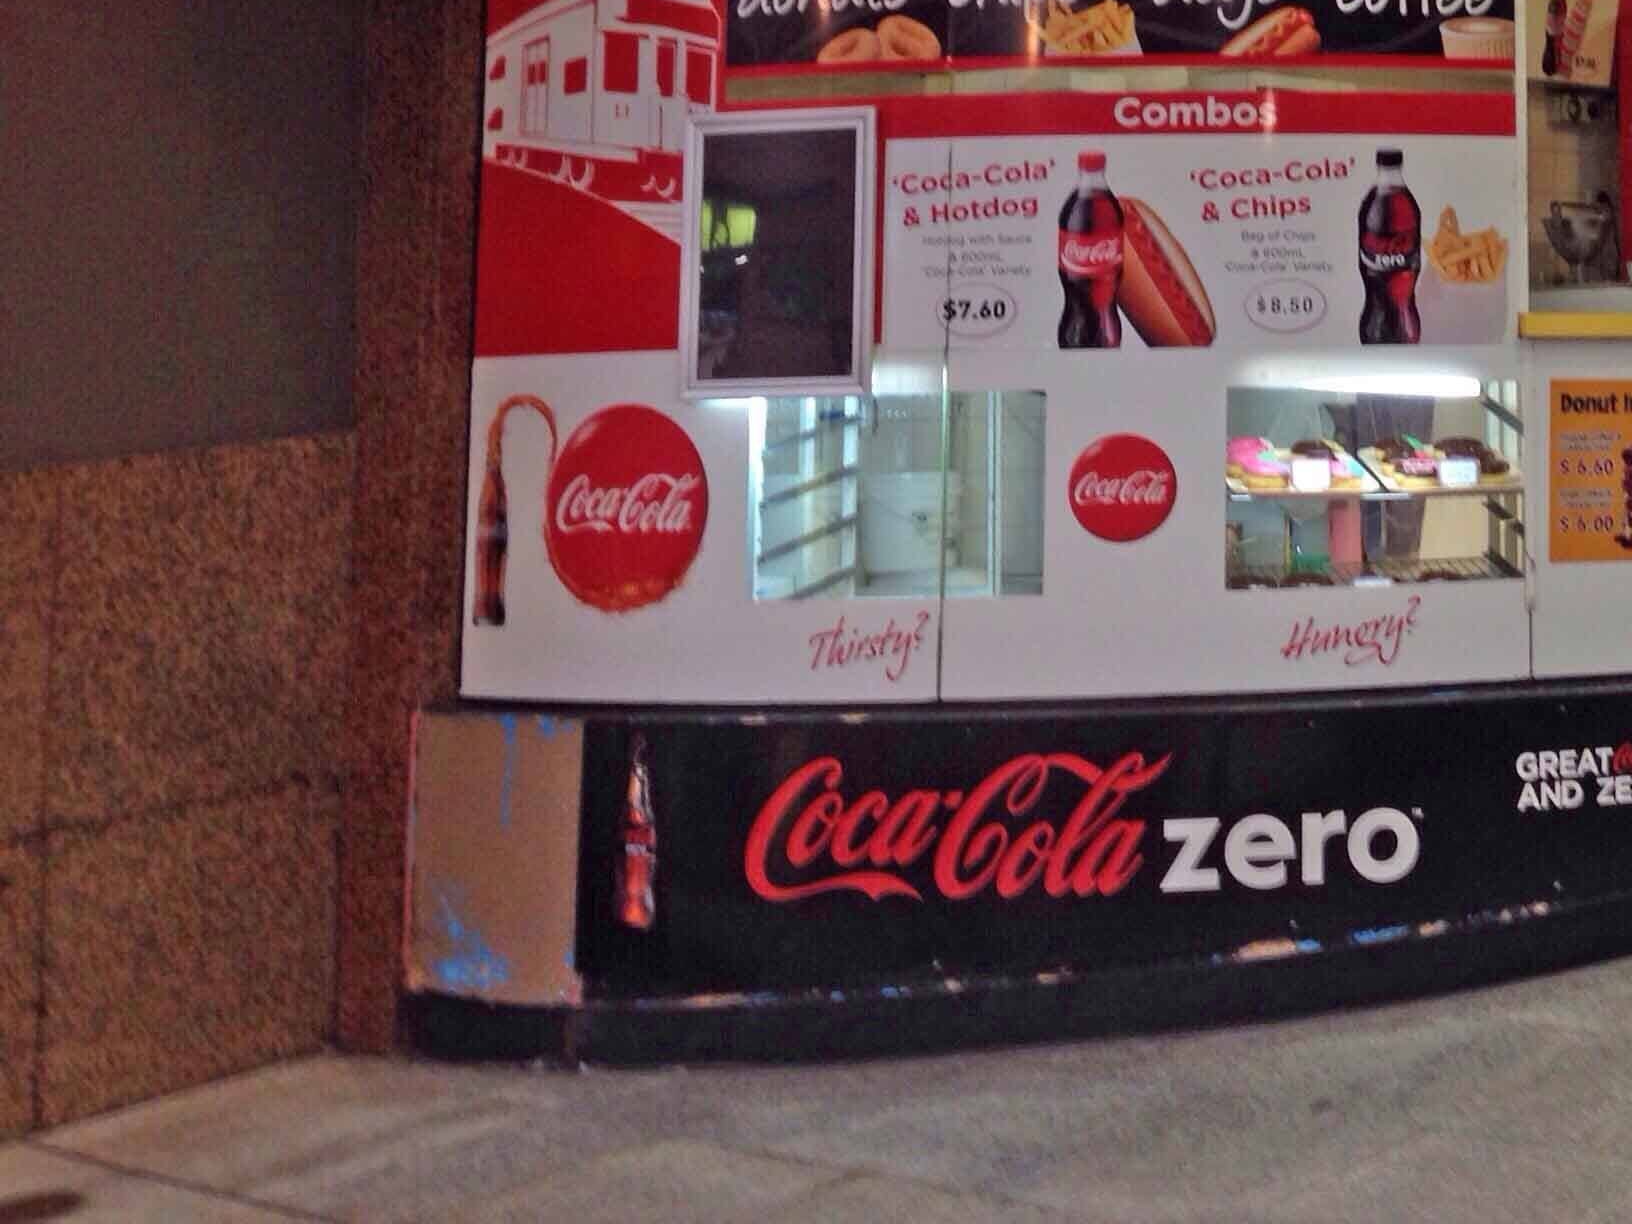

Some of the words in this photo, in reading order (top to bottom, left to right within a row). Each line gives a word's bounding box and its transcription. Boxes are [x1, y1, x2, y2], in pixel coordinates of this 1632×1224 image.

[1113, 95, 1278, 127] Combos
[902, 206, 921, 227] &
[930, 196, 1040, 224] Hotdog
[1201, 200, 1220, 222] &
[1230, 193, 1312, 220] Chips
[942, 297, 1006, 321] $7.60
[1256, 294, 1314, 316] $8.50
[1560, 392, 1618, 414] Donut
[556, 473, 697, 534] Coca-Cola
[1073, 470, 1170, 505] Coca-Cola
[809, 609, 929, 682] Thirsty?
[1514, 745, 1613, 784] GREAT
[1516, 778, 1585, 813] AND
[744, 751, 1172, 904] Coca-Cola
[1160, 804, 1420, 895] zero
